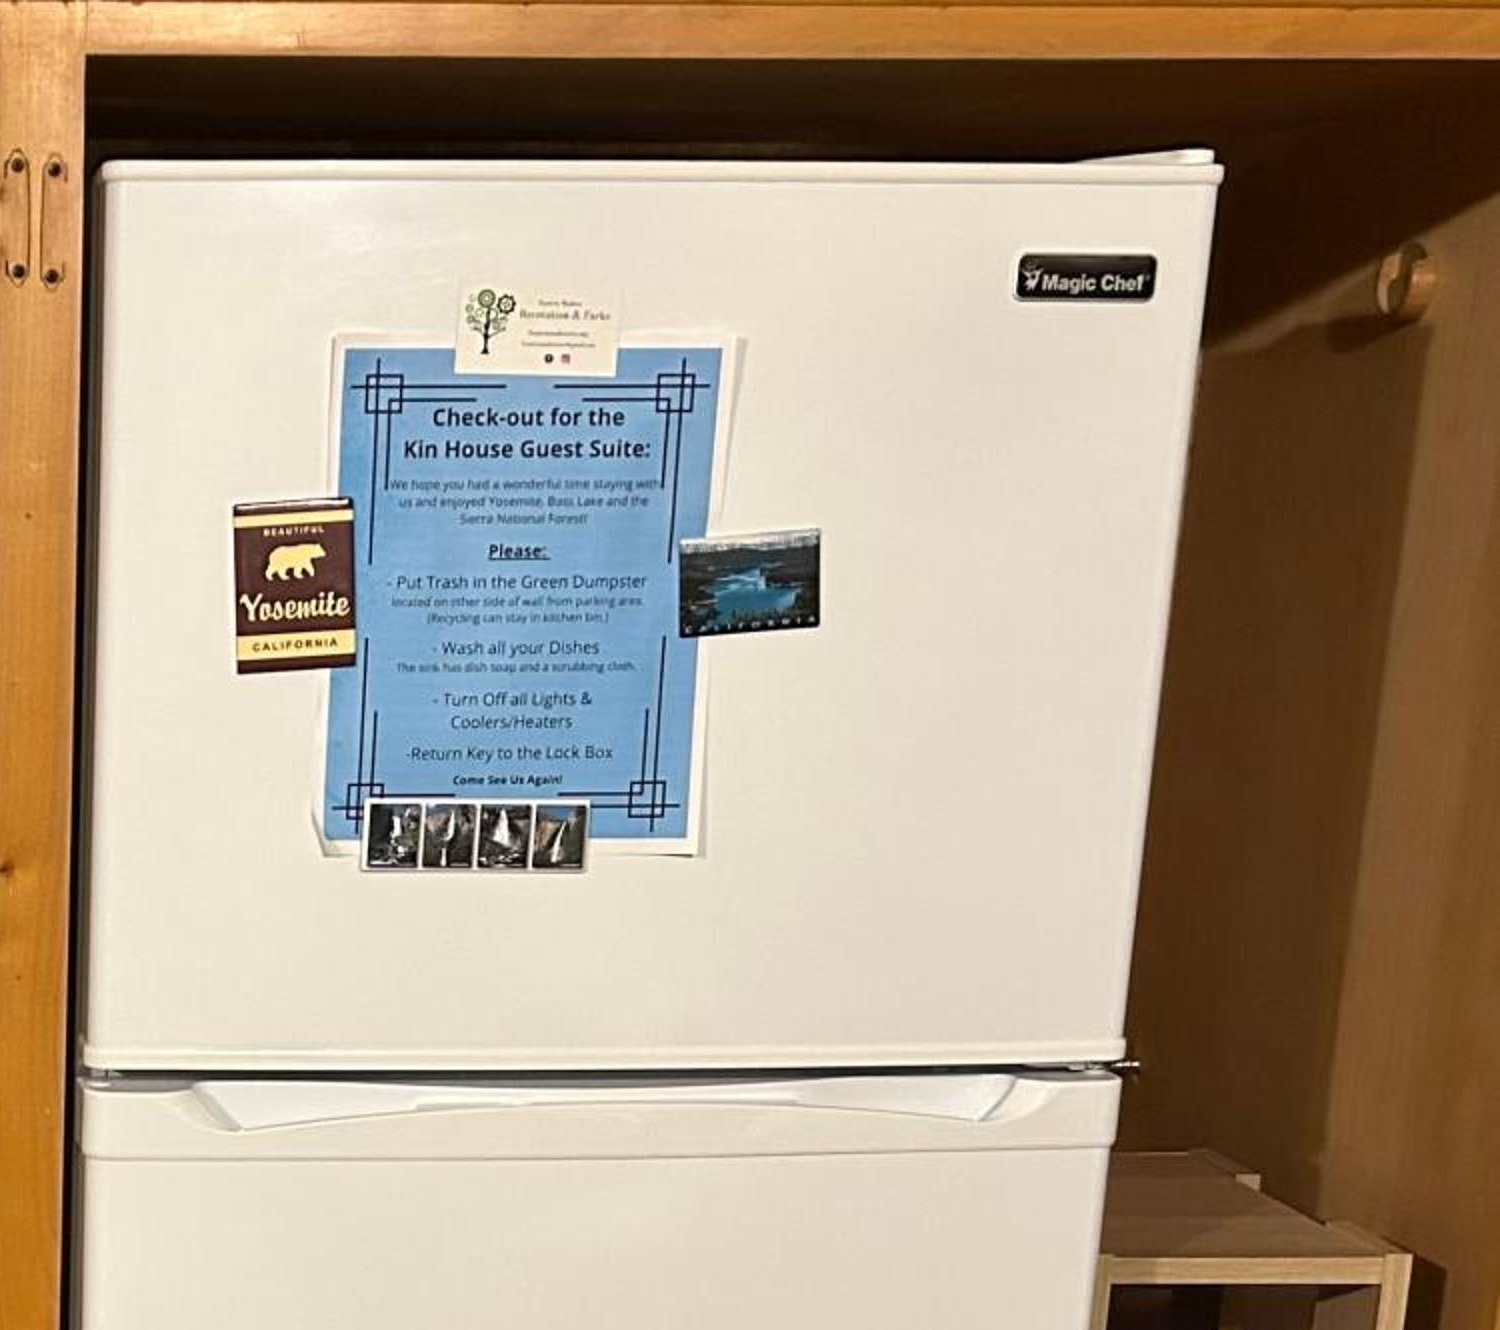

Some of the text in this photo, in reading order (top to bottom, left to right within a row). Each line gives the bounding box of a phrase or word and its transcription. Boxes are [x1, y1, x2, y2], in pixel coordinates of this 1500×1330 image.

[1041, 274, 1145, 295] Magic Chef
[432, 407, 626, 427] Check-out for the
[403, 439, 652, 459] Kin House Guest Suite:
[389, 480, 409, 491] We
[411, 479, 440, 494] hope
[441, 482, 465, 494] you
[467, 479, 491, 491] had
[503, 479, 562, 491] wonderful
[565, 479, 590, 490] time
[593, 480, 633, 494] staying
[415, 497, 438, 508] and
[440, 497, 485, 511] enjoyed
[577, 496, 603, 507] Lake
[606, 496, 629, 507] and
[631, 496, 649, 507] the
[460, 514, 494, 525] Sierra
[497, 513, 545, 525] National
[263, 525, 326, 538] BEAUTIFUL
[488, 544, 551, 561] Please:
[397, 576, 422, 590] Put
[426, 575, 469, 590] Trash
[473, 576, 487, 590] in
[491, 575, 518, 590] the
[521, 575, 569, 589] Green
[573, 575, 647, 591] Dumpster
[239, 591, 351, 622] Yosemite
[252, 638, 339, 653] CALIFORNIA
[441, 640, 484, 655] Wash
[487, 640, 506, 656] all
[509, 643, 544, 659] your
[548, 640, 599, 655] Dishes
[444, 692, 478, 707] Turn
[483, 692, 508, 707] Off
[510, 692, 528, 707] all
[531, 692, 577, 710] Lights
[580, 692, 593, 706] &
[450, 714, 573, 730] Coolers/Heaters
[406, 745, 614, 764] -Return Key to the Lock Box
[452, 774, 563, 787] Come See Us Again!
